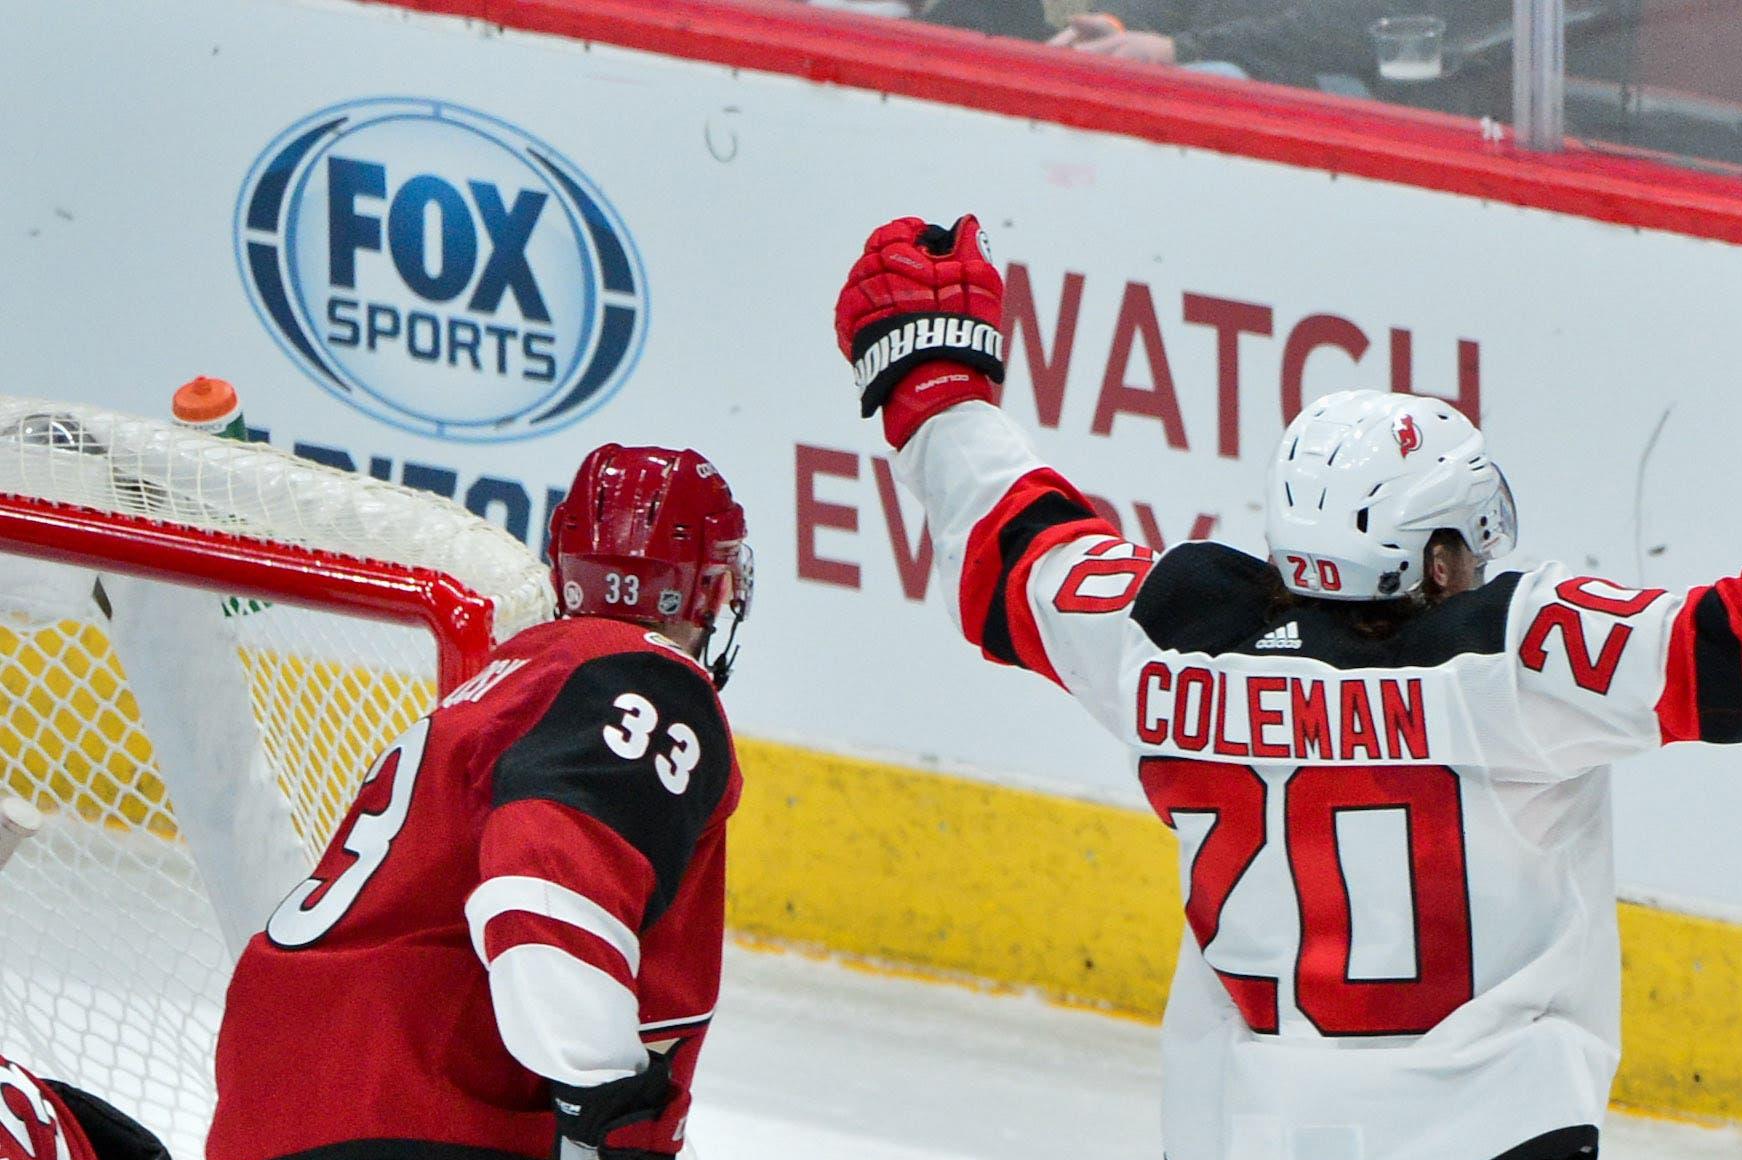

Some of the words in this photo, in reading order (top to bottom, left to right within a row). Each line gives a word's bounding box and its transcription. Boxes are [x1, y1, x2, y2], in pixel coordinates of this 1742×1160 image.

[328, 156, 552, 321] FOX
[328, 296, 556, 382] SPORTS
[1000, 262, 1481, 458] WATCH
[605, 573, 639, 605] 33
[1287, 555, 1342, 591] 20
[1518, 576, 1668, 696] 20
[603, 692, 700, 795] 33
[1137, 660, 1430, 762] COLEMAN
[1138, 755, 1475, 1037] 20
